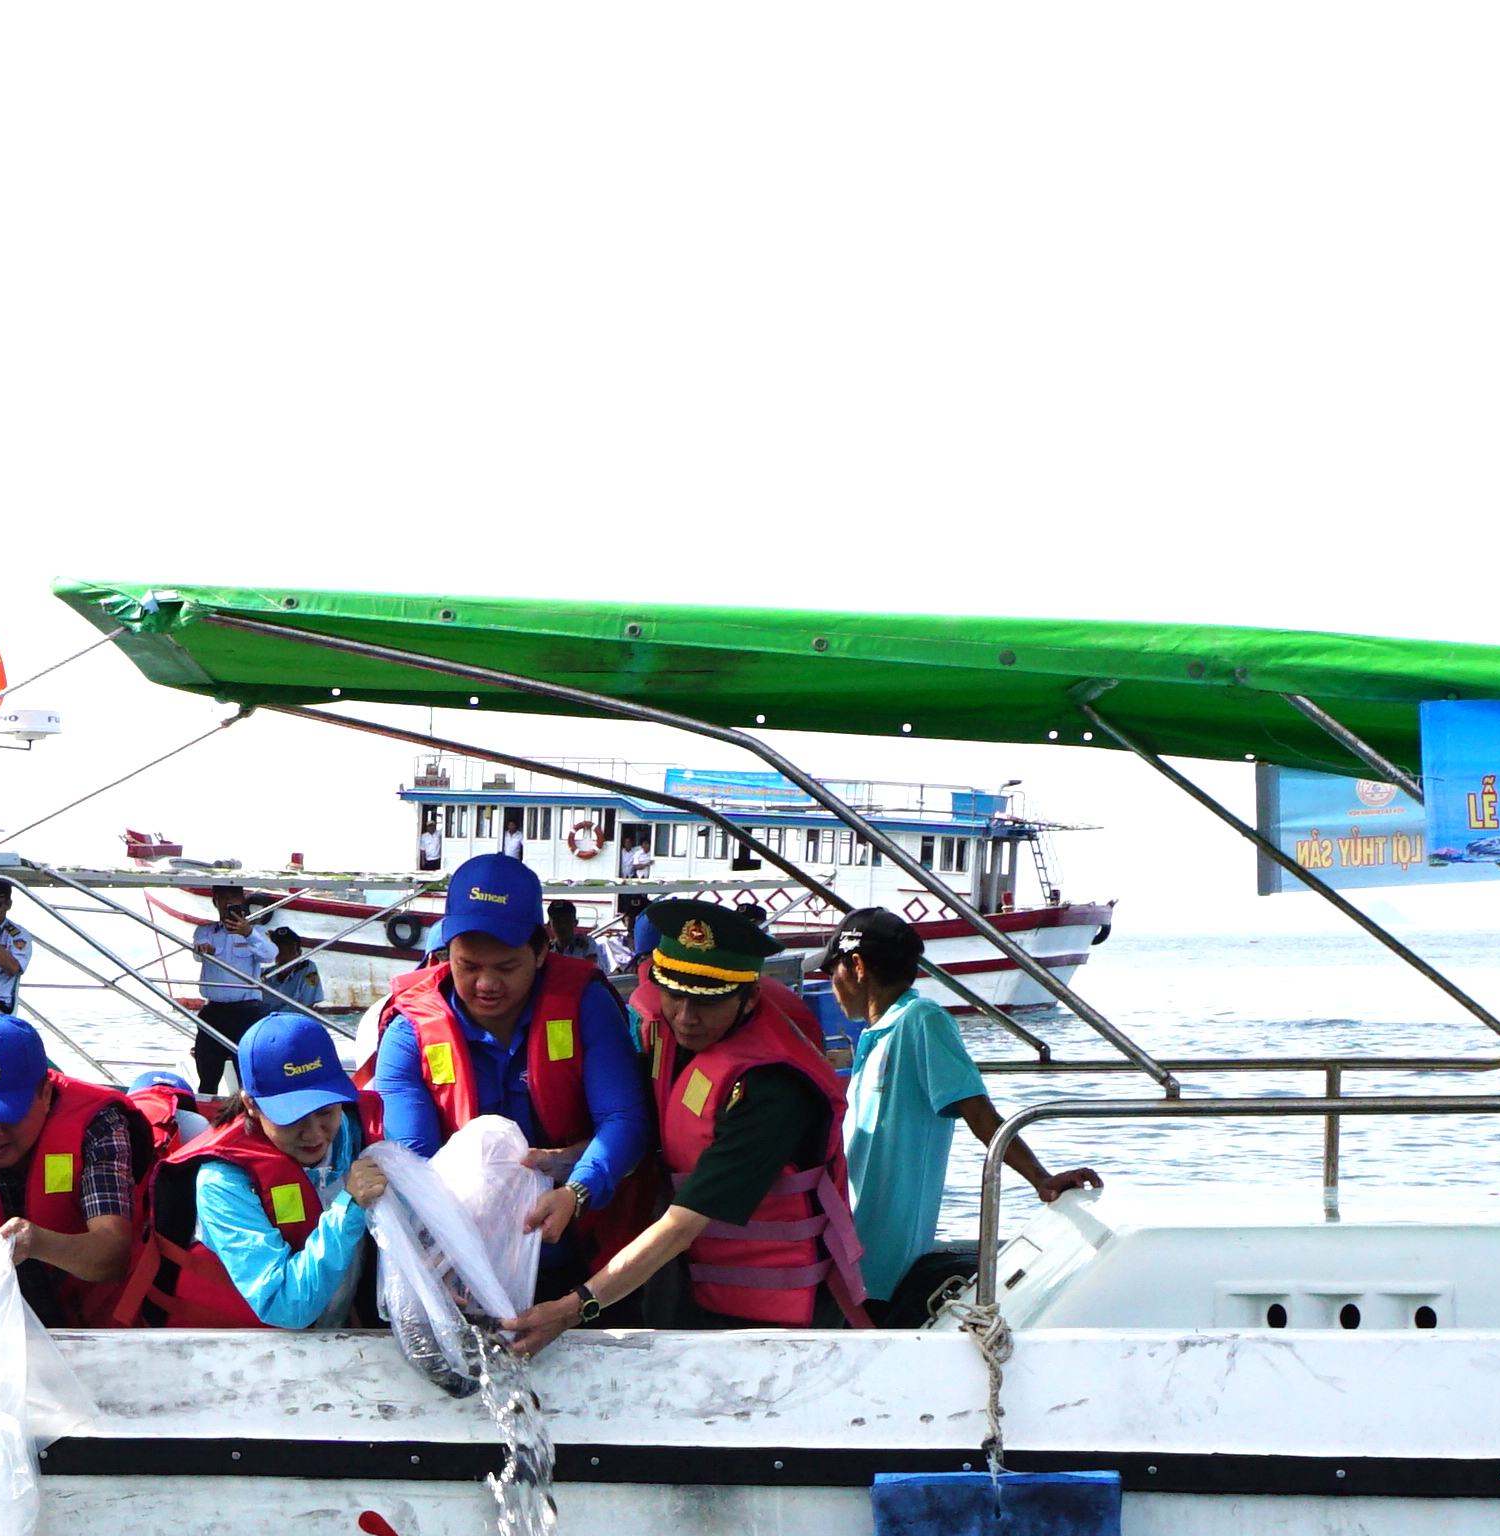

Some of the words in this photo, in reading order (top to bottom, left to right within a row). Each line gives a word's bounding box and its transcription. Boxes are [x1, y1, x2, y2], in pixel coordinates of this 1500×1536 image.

[1467, 774, 1499, 829] LỄ
[469, 886, 508, 905] Sanest
[283, 1056, 323, 1077] Sanest
